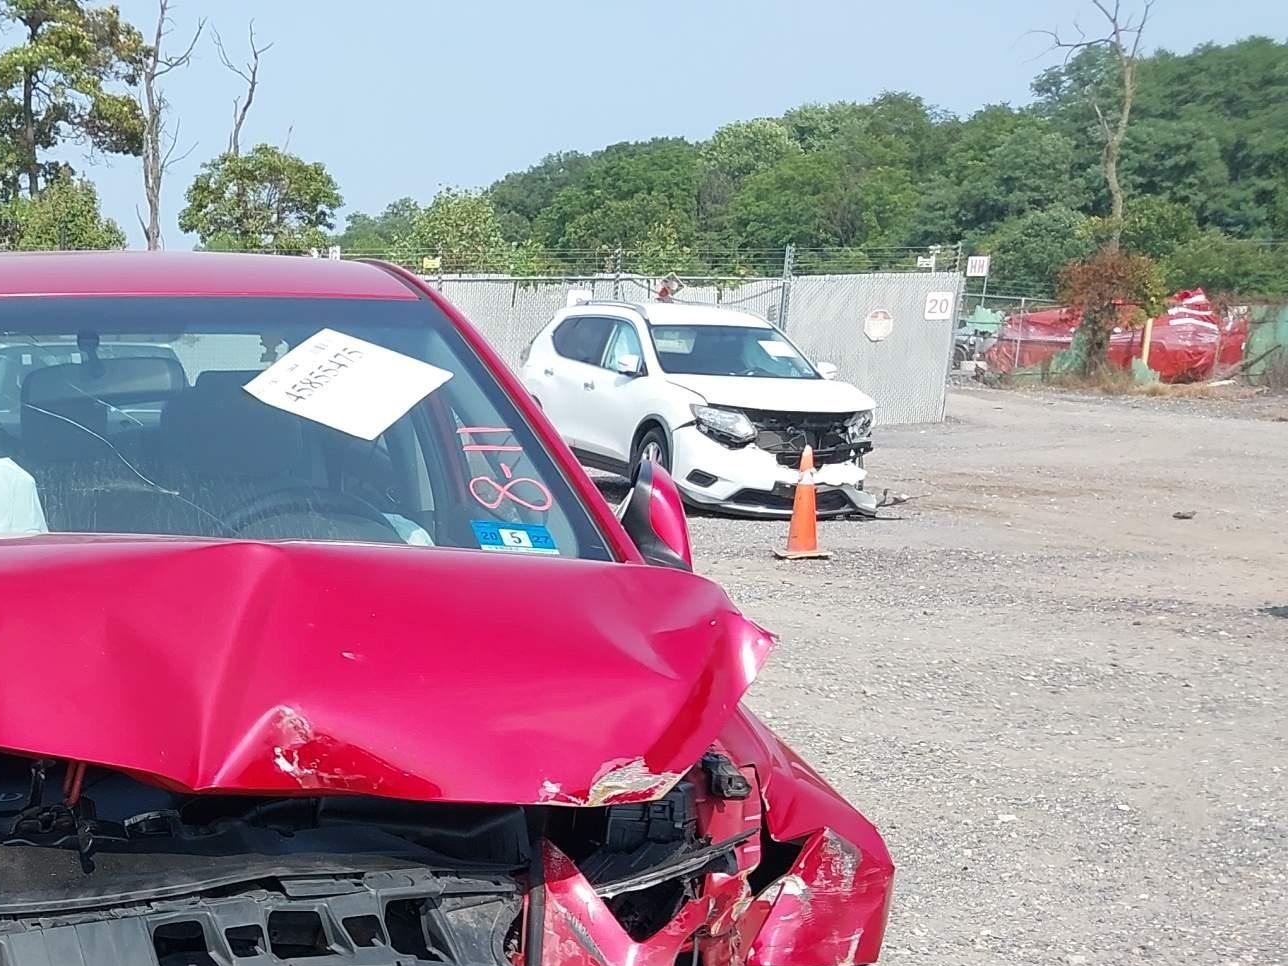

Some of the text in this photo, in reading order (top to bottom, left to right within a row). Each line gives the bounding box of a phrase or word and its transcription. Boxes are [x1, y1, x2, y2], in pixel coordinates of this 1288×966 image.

[927, 298, 950, 314] 20
[285, 346, 364, 402] 45855475
[480, 530, 551, 545] 20 5 27
